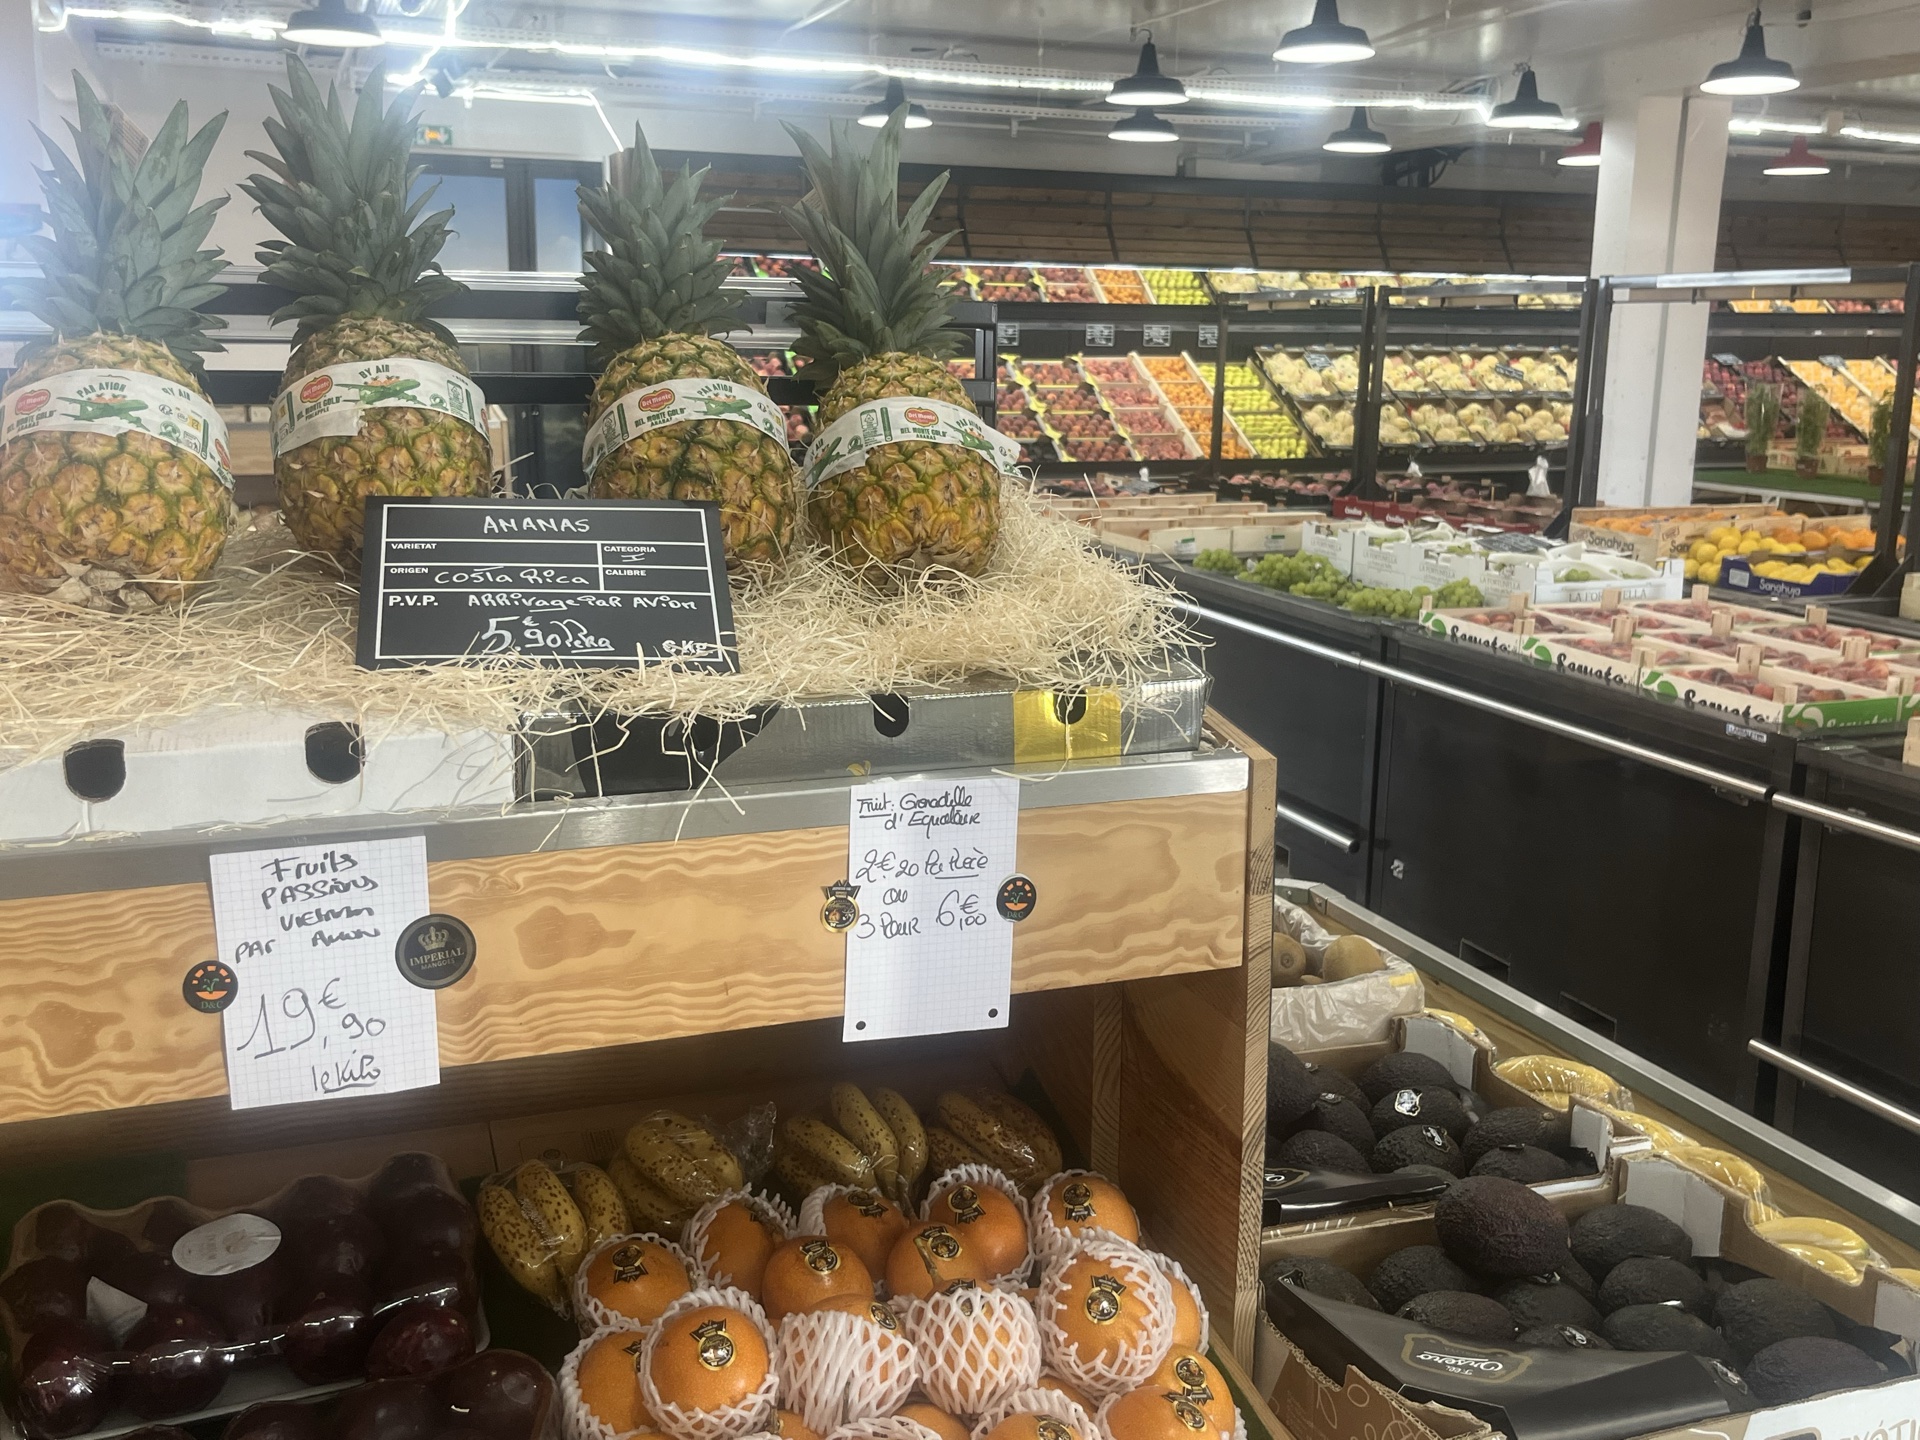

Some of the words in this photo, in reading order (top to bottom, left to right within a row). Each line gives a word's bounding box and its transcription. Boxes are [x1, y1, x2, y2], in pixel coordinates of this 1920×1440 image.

[359, 368, 372, 379] BY
[376, 364, 390, 374] AIR
[76, 384, 97, 398] PAR
[98, 381, 127, 393] AVION
[697, 385, 712, 396] PAR
[712, 383, 733, 394] AVION
[651, 393, 672, 404] Monte
[646, 411, 666, 423] MONTE
[912, 427, 930, 435] MONTE
[483, 515, 590, 534] ANANAS
[605, 569, 647, 577] CALIBRE
[389, 595, 439, 606] P.V.P.
[1568, 591, 1582, 603] LA
[857, 914, 876, 939] 3
[410, 947, 465, 967] IMPERIAL
[201, 1000, 224, 1009] D&C
[1415, 1352, 1504, 1372] Orsero
